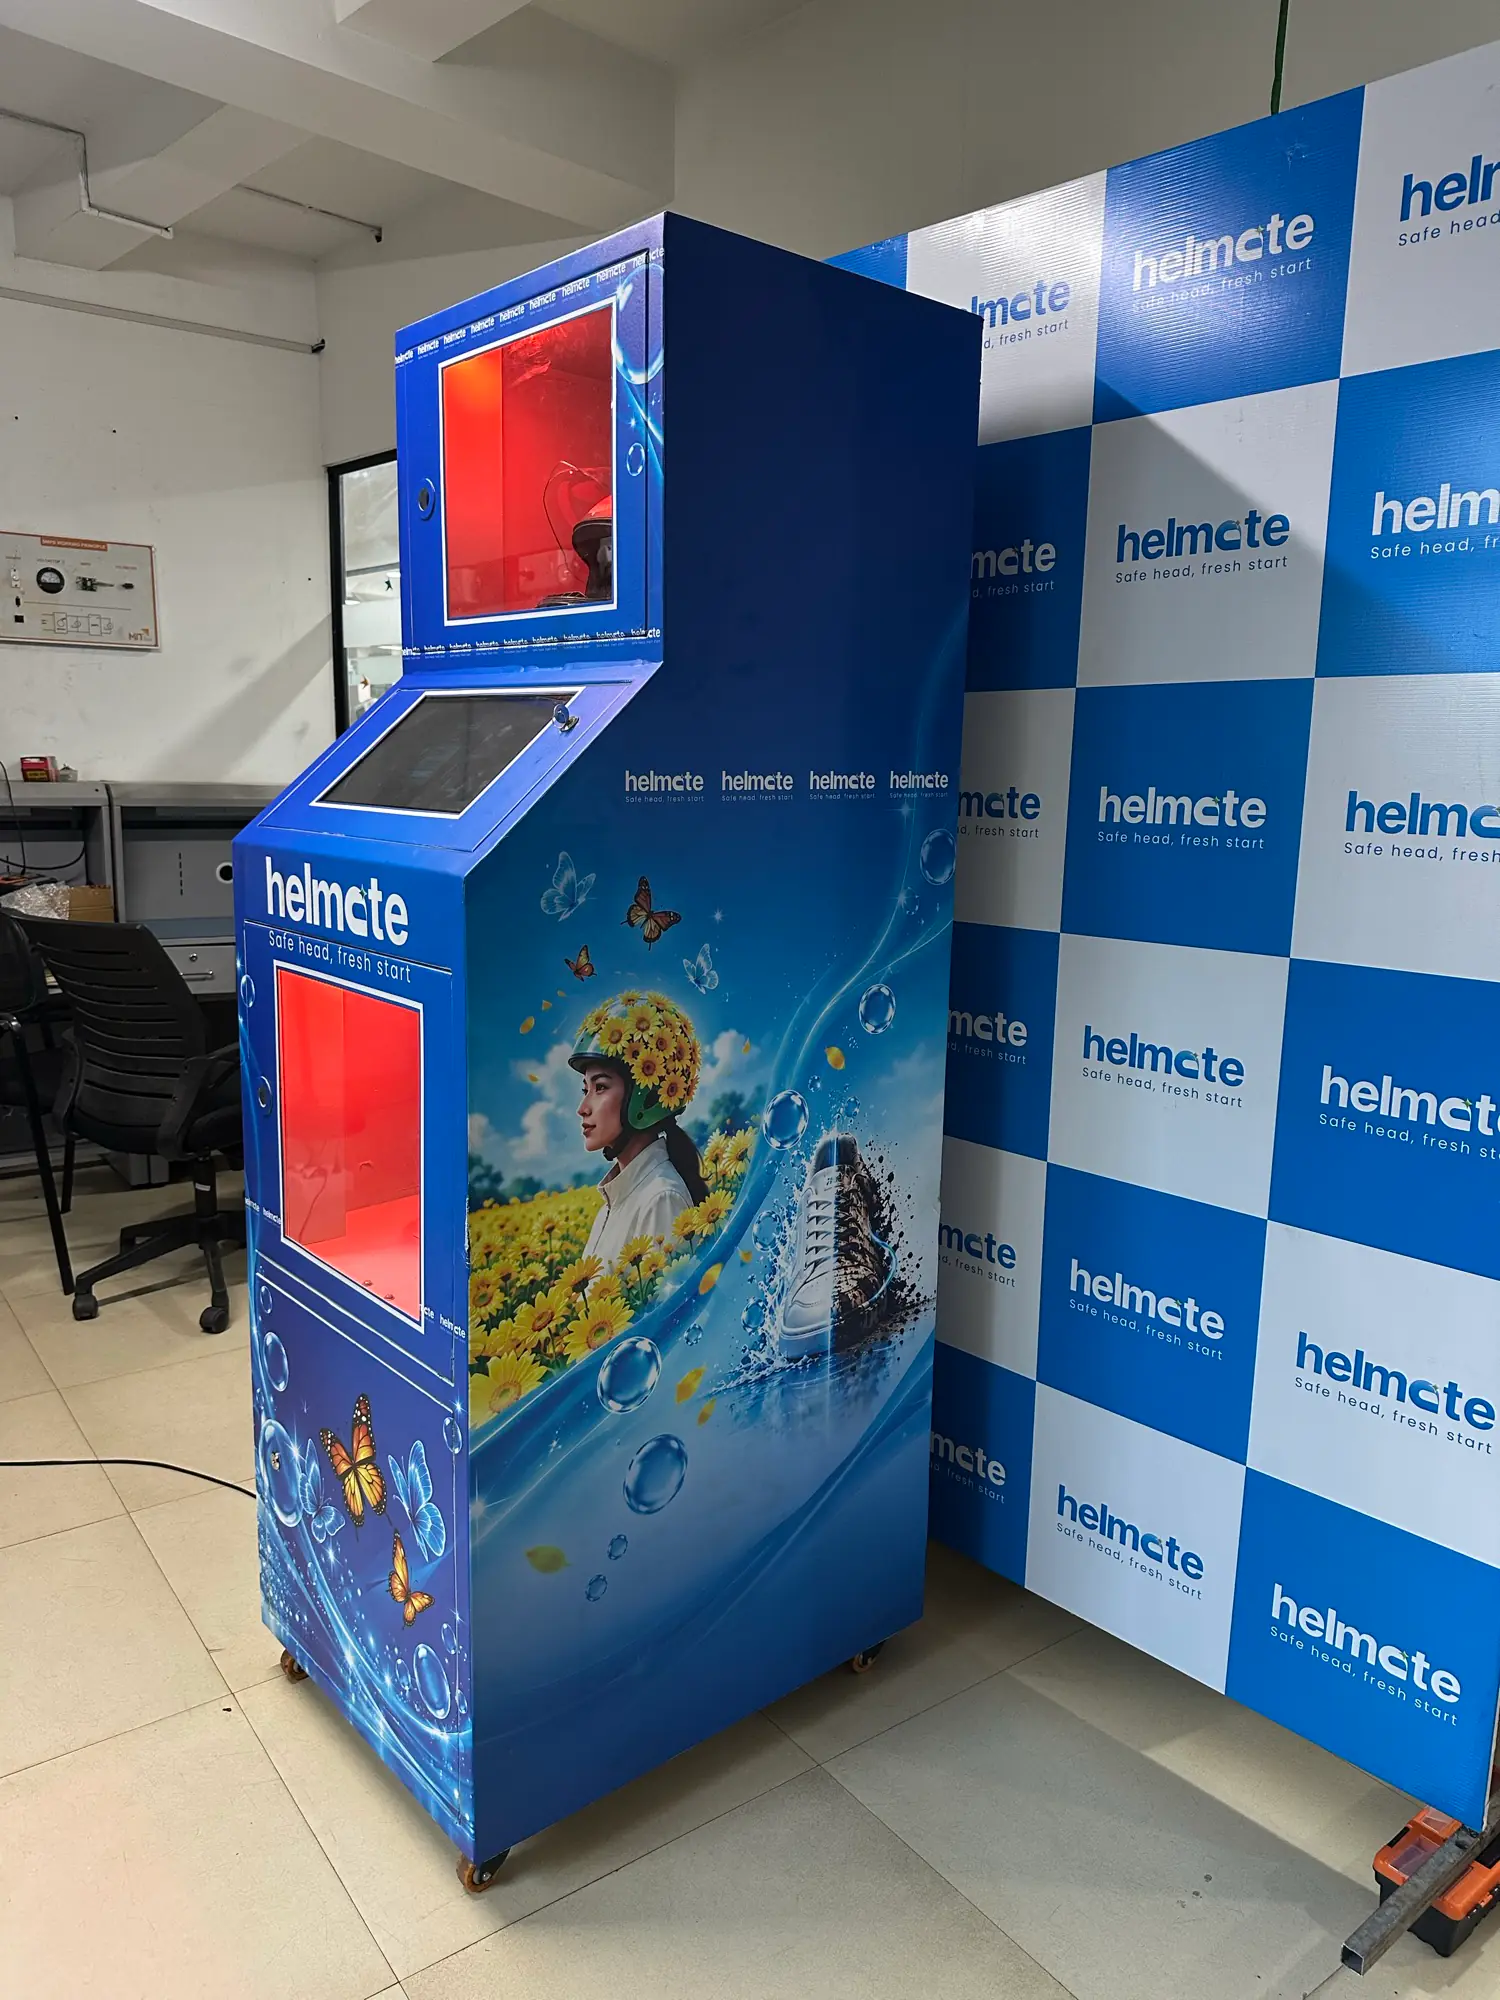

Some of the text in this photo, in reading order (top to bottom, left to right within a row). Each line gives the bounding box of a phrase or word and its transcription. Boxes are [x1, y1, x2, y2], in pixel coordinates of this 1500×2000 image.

[1398, 209, 1500, 246] Safe head
[1222, 270, 1263, 291] fresh
[1270, 257, 1312, 279] start
[1000, 329, 1031, 345] fresh
[1037, 320, 1068, 336] start
[1372, 483, 1500, 535] helm
[1371, 544, 1411, 558] Safe
[1420, 538, 1474, 554] head,
[1116, 556, 1288, 583] Safe head, fresh start
[988, 584, 1018, 598] fresh
[1024, 580, 1054, 592] start
[976, 826, 1004, 836] fresh
[1010, 828, 1039, 838] start
[1346, 791, 1500, 838] helma
[1098, 831, 1264, 849] Safe head, fresh start
[1345, 842, 1500, 862] Safe head, fresh
[269, 930, 411, 983] Safe head, fresh start
[965, 1043, 992, 1058] fresh
[998, 1052, 1026, 1065] start
[1082, 1067, 1242, 1108] Safe head, fresh start
[1321, 1065, 1500, 1136] helmat
[1320, 1114, 1356, 1131] Safe
[1365, 1122, 1414, 1144] head,
[1423, 1134, 1470, 1154] fresh
[956, 1258, 983, 1276] fresh
[988, 1272, 1015, 1287] start
[1070, 1298, 1222, 1361] Safe head, fresh start
[1295, 1377, 1491, 1454] Safe head, fresh start
[979, 1485, 1004, 1504] start
[1057, 1522, 1202, 1600] Safe head, fresh start
[1270, 1626, 1456, 1726] Safe head, fresh start
